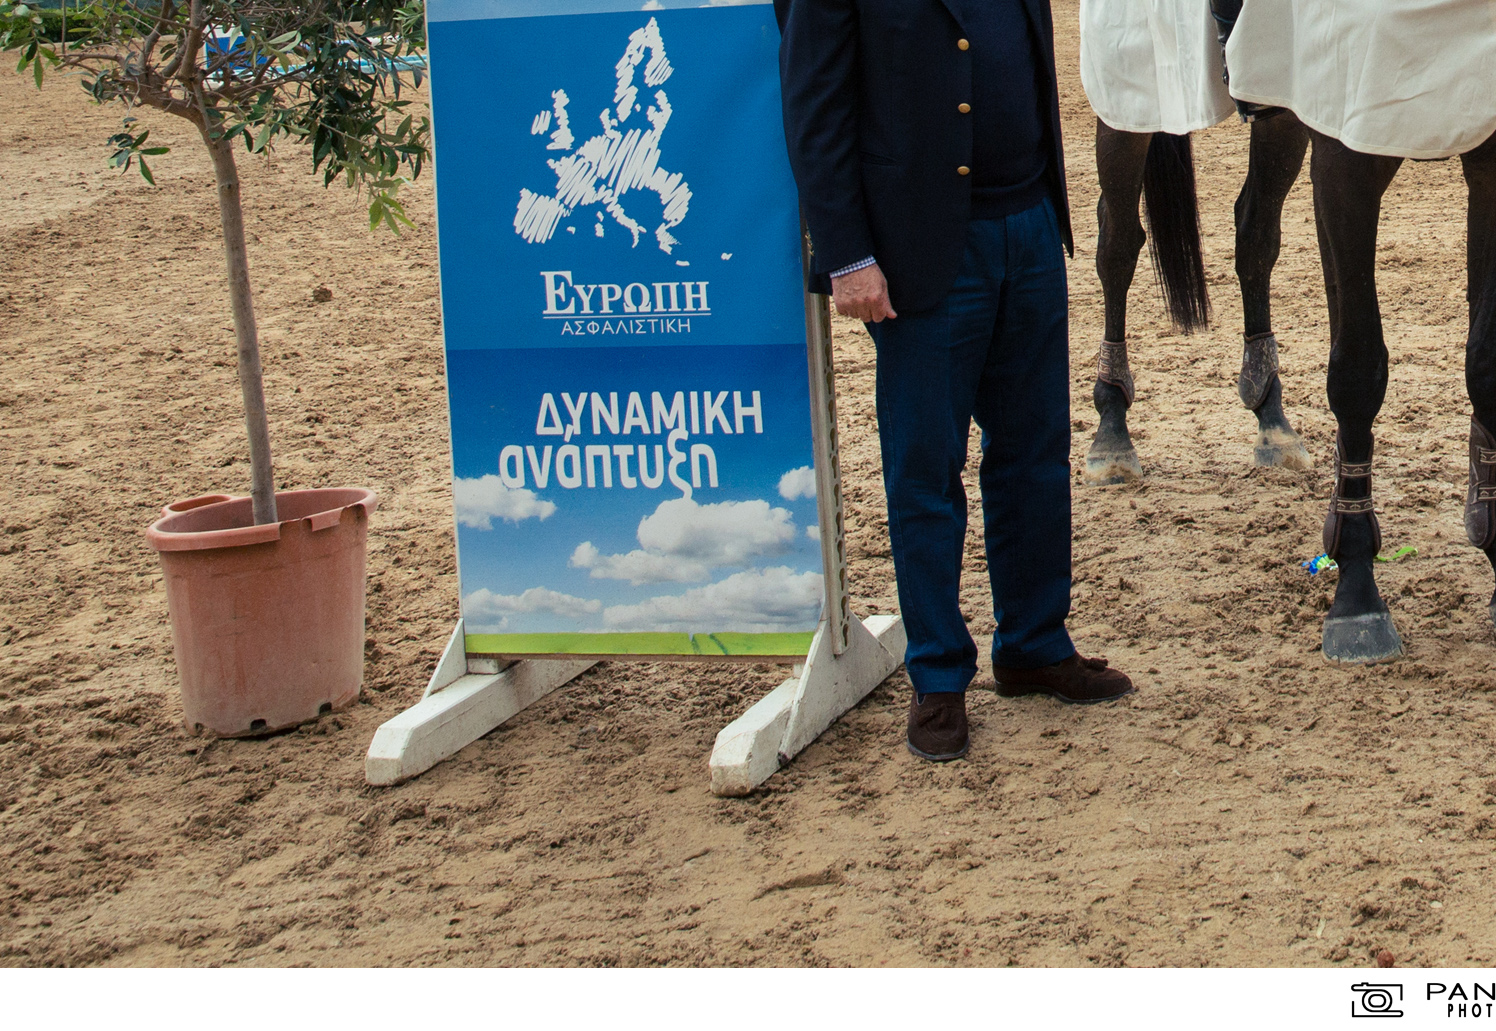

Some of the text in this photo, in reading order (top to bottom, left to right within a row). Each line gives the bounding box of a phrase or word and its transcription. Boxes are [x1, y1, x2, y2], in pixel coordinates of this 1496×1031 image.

[561, 318, 691, 336] ΑΣΦΑΛΙΣΤΙΚΗ
[536, 390, 764, 435] ΔΥΝΑΜΙΚΗ
[500, 424, 719, 501] ανάπτυξη
